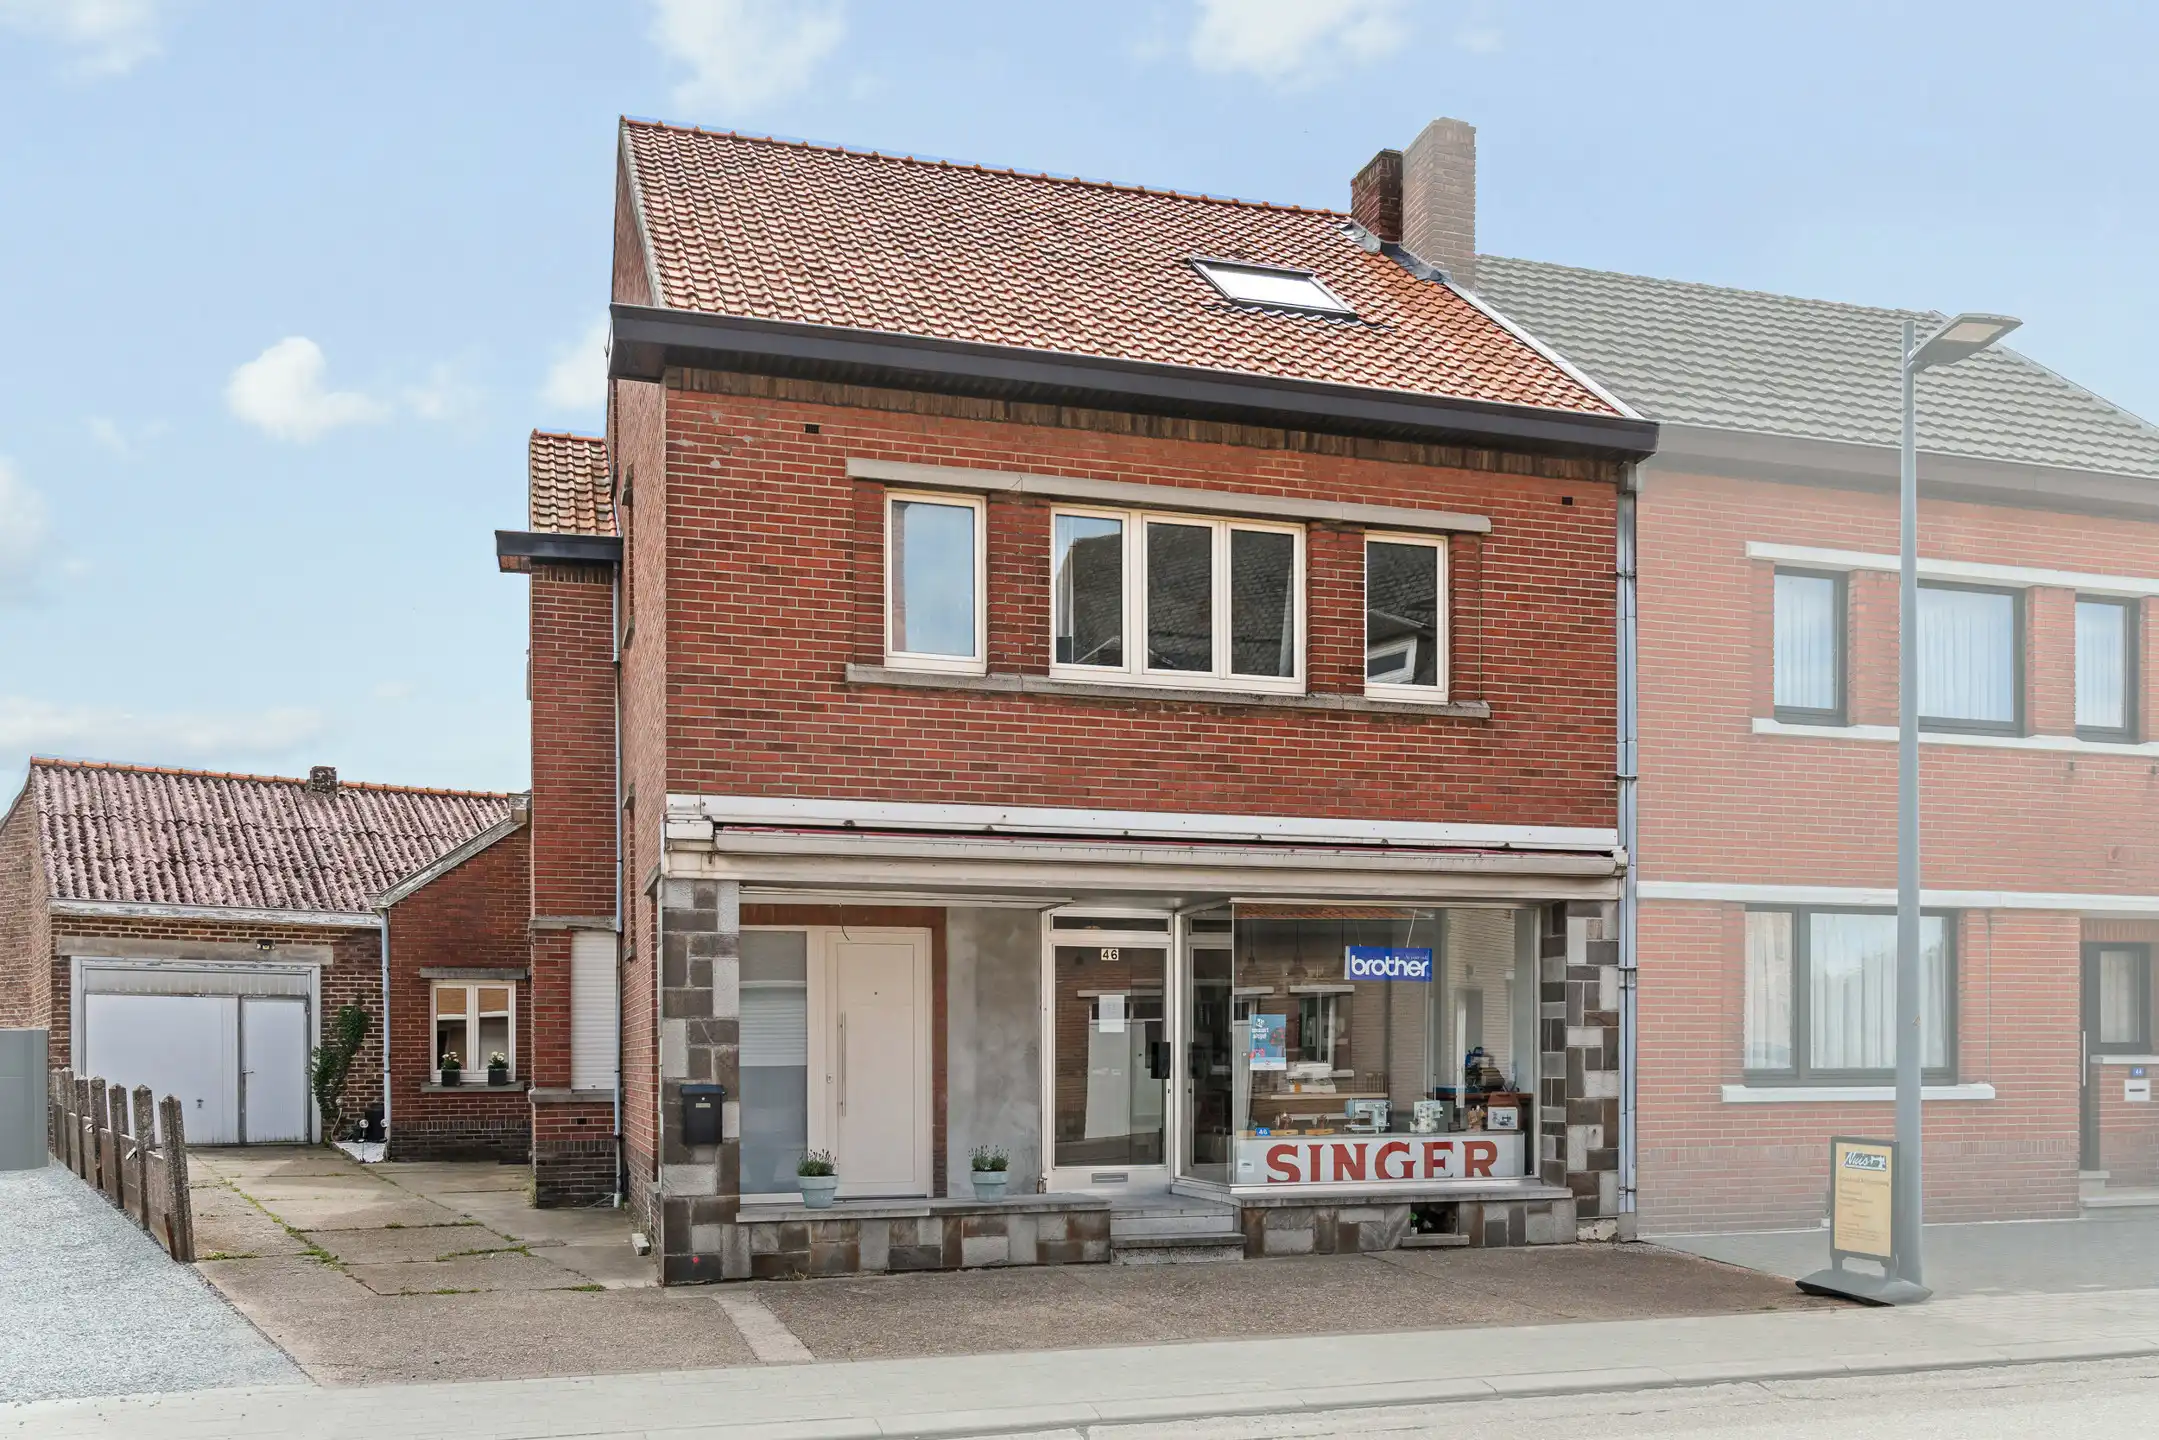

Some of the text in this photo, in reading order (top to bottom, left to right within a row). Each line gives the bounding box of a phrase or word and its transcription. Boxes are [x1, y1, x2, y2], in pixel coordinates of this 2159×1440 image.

[1102, 949, 1118, 960] 46
[1351, 954, 1429, 977] brother
[1265, 1140, 1498, 1184] SINGER
